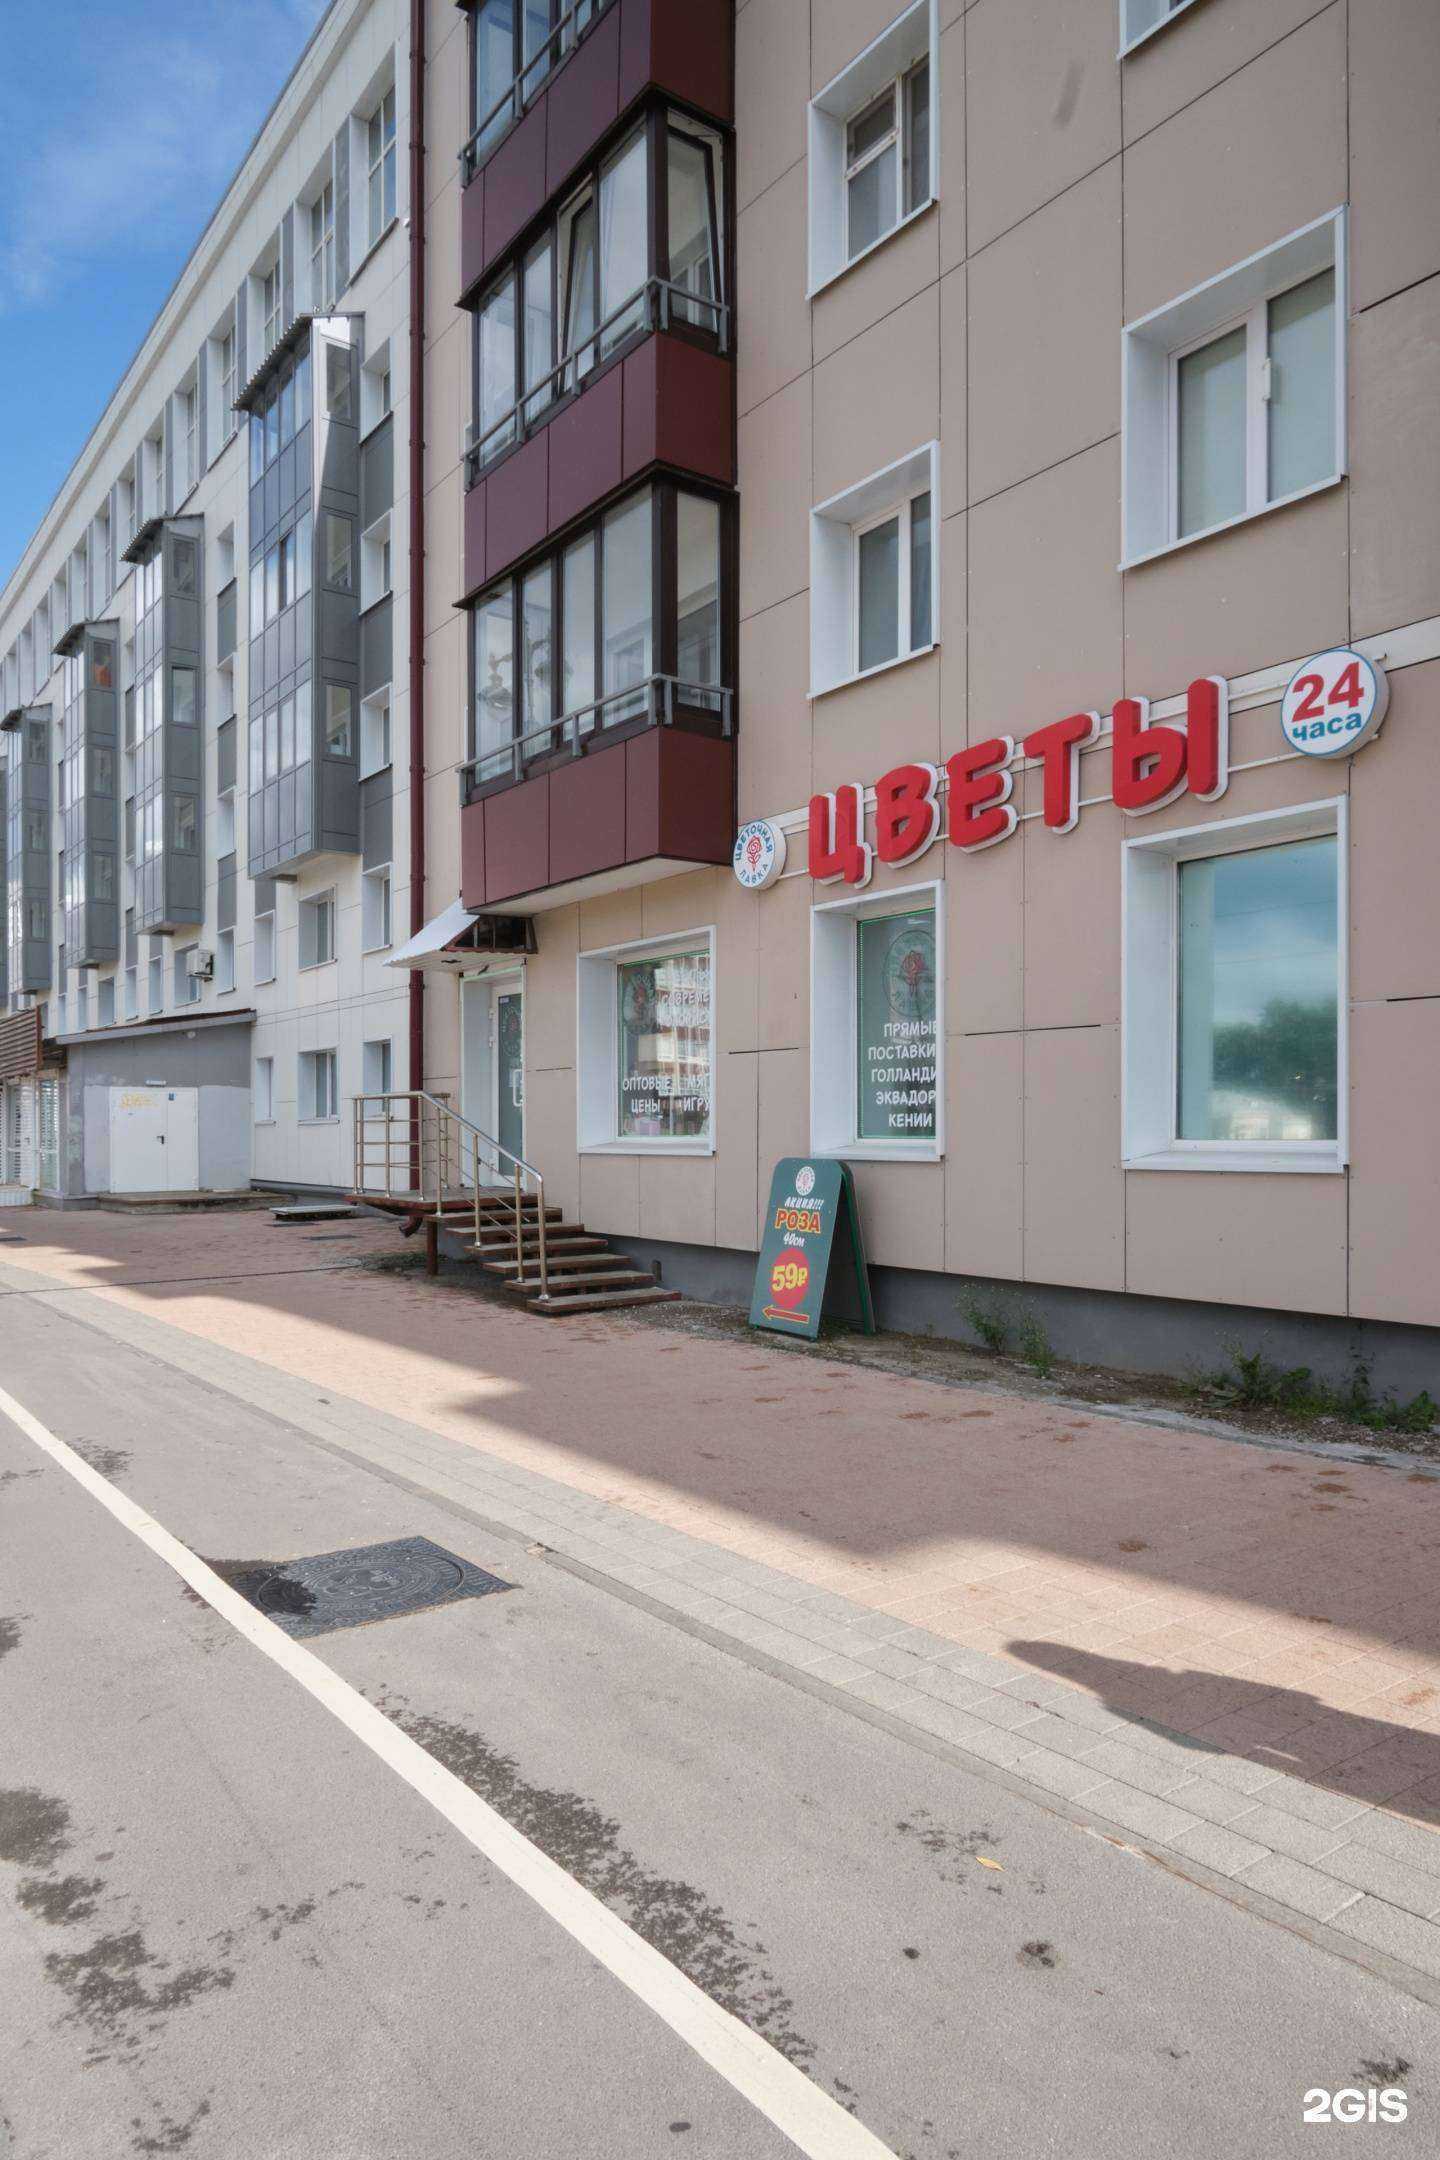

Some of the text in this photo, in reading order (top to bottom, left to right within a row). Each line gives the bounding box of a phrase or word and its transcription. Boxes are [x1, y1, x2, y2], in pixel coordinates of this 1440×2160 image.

[1292, 661, 1364, 722] 24
[1292, 712, 1362, 741] часа
[808, 676, 1227, 887] ЦВЕТЫ
[735, 824, 773, 860] ЦВЕТОЧНАЯ
[740, 864, 768, 883] ЛАВКА
[868, 1043, 937, 1060] ПОСТАВКИ
[623, 1076, 672, 1091] ОПТОВЫЕ
[631, 1098, 660, 1114] ЦЕНЫ
[889, 1113, 932, 1128] КЕНИИ
[775, 1208, 821, 1233] РОЗА
